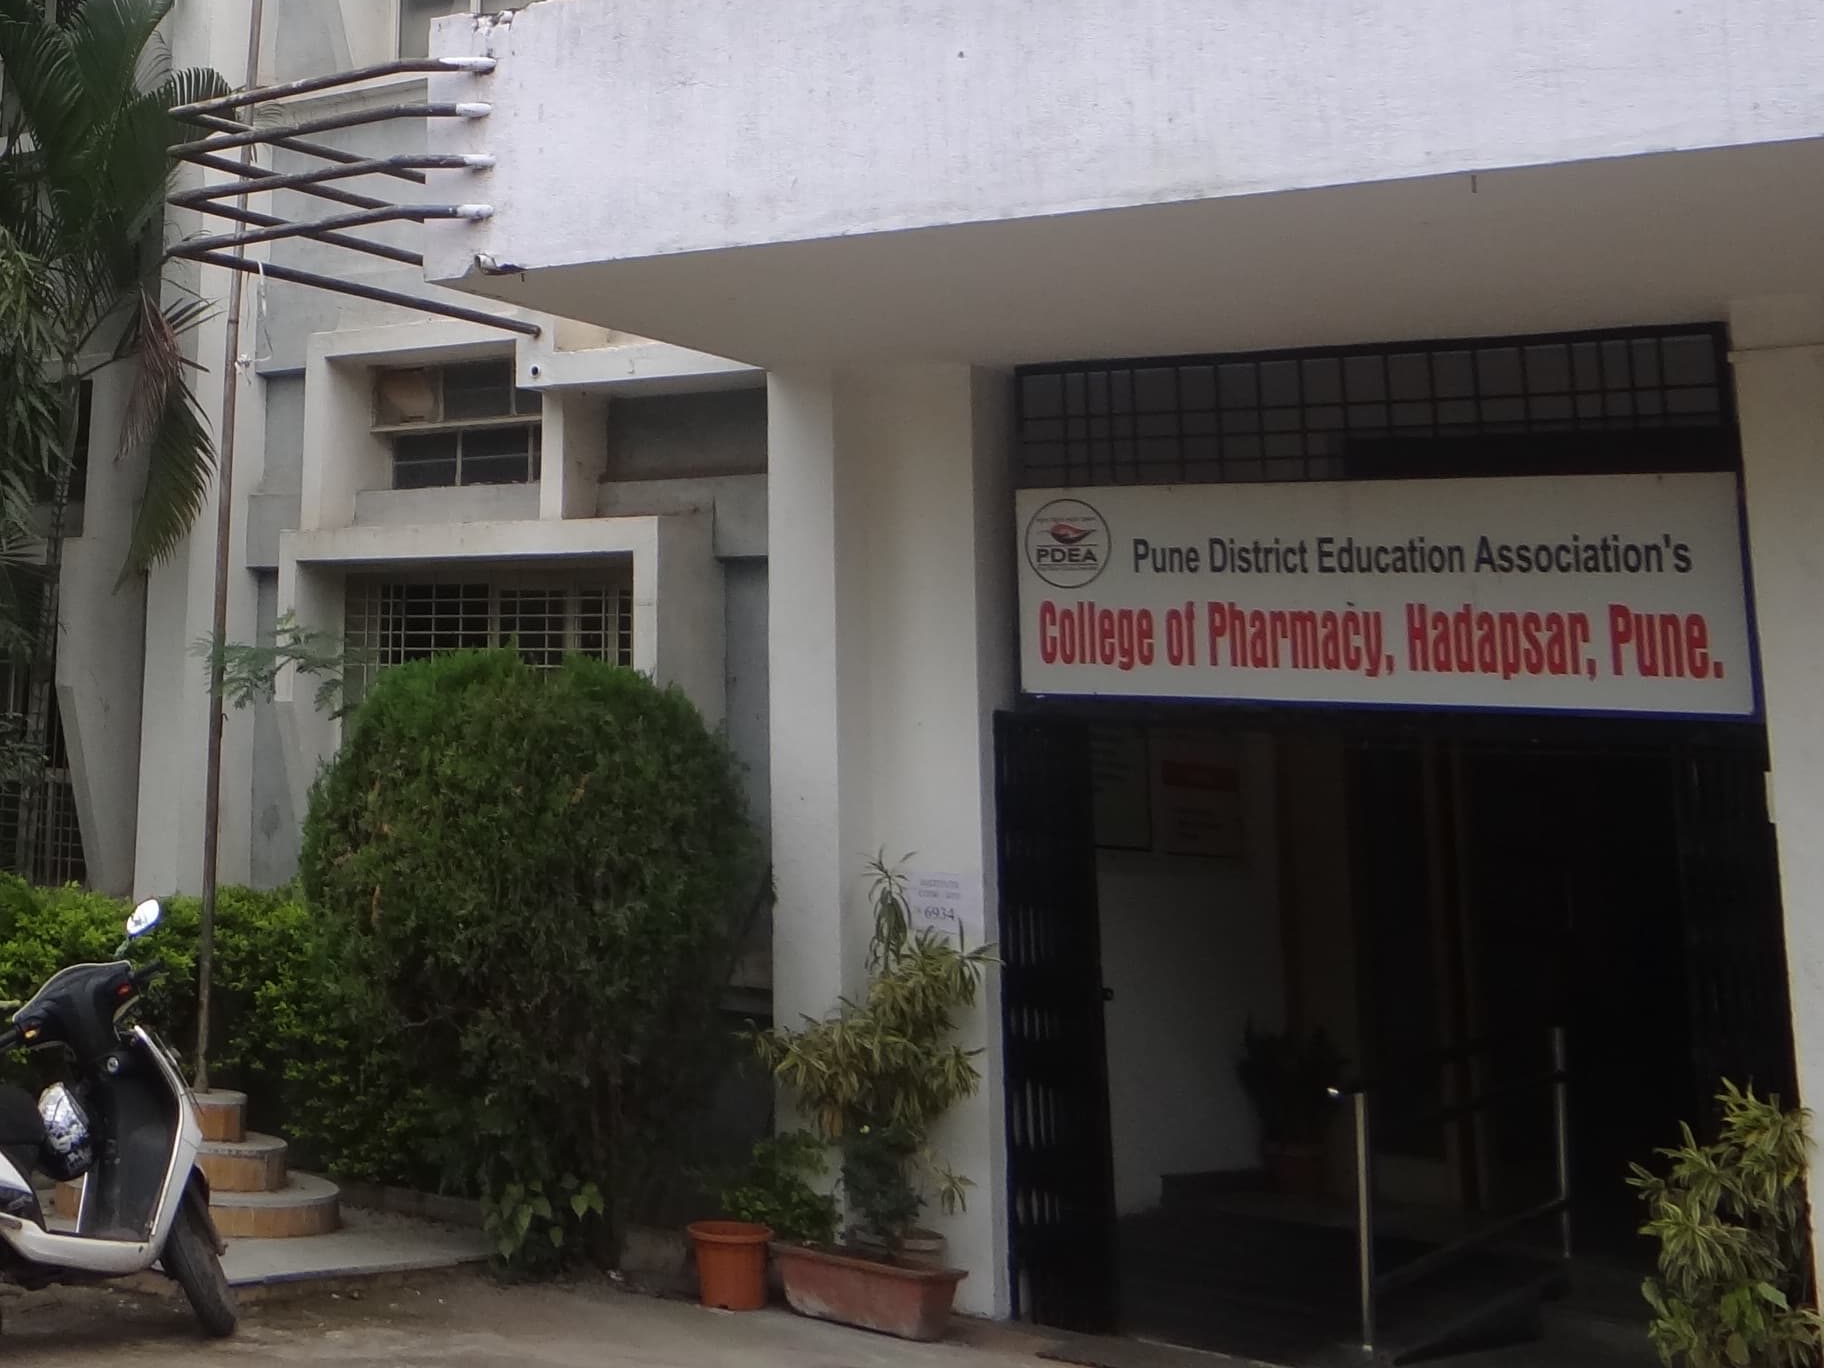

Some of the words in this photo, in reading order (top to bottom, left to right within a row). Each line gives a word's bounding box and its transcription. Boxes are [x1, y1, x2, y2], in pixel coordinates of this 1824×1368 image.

[1036, 547, 1098, 563] PDEA
[1132, 537, 1201, 574] Pune
[1208, 536, 1309, 574] District
[1316, 535, 1466, 574] Education
[1473, 533, 1693, 574] Association's
[1039, 599, 1156, 672] College
[1165, 600, 1196, 667] of
[1206, 600, 1395, 677] Pharmacy,
[1405, 602, 1598, 681] Hadapsar,
[1607, 603, 1725, 680] Pune.
